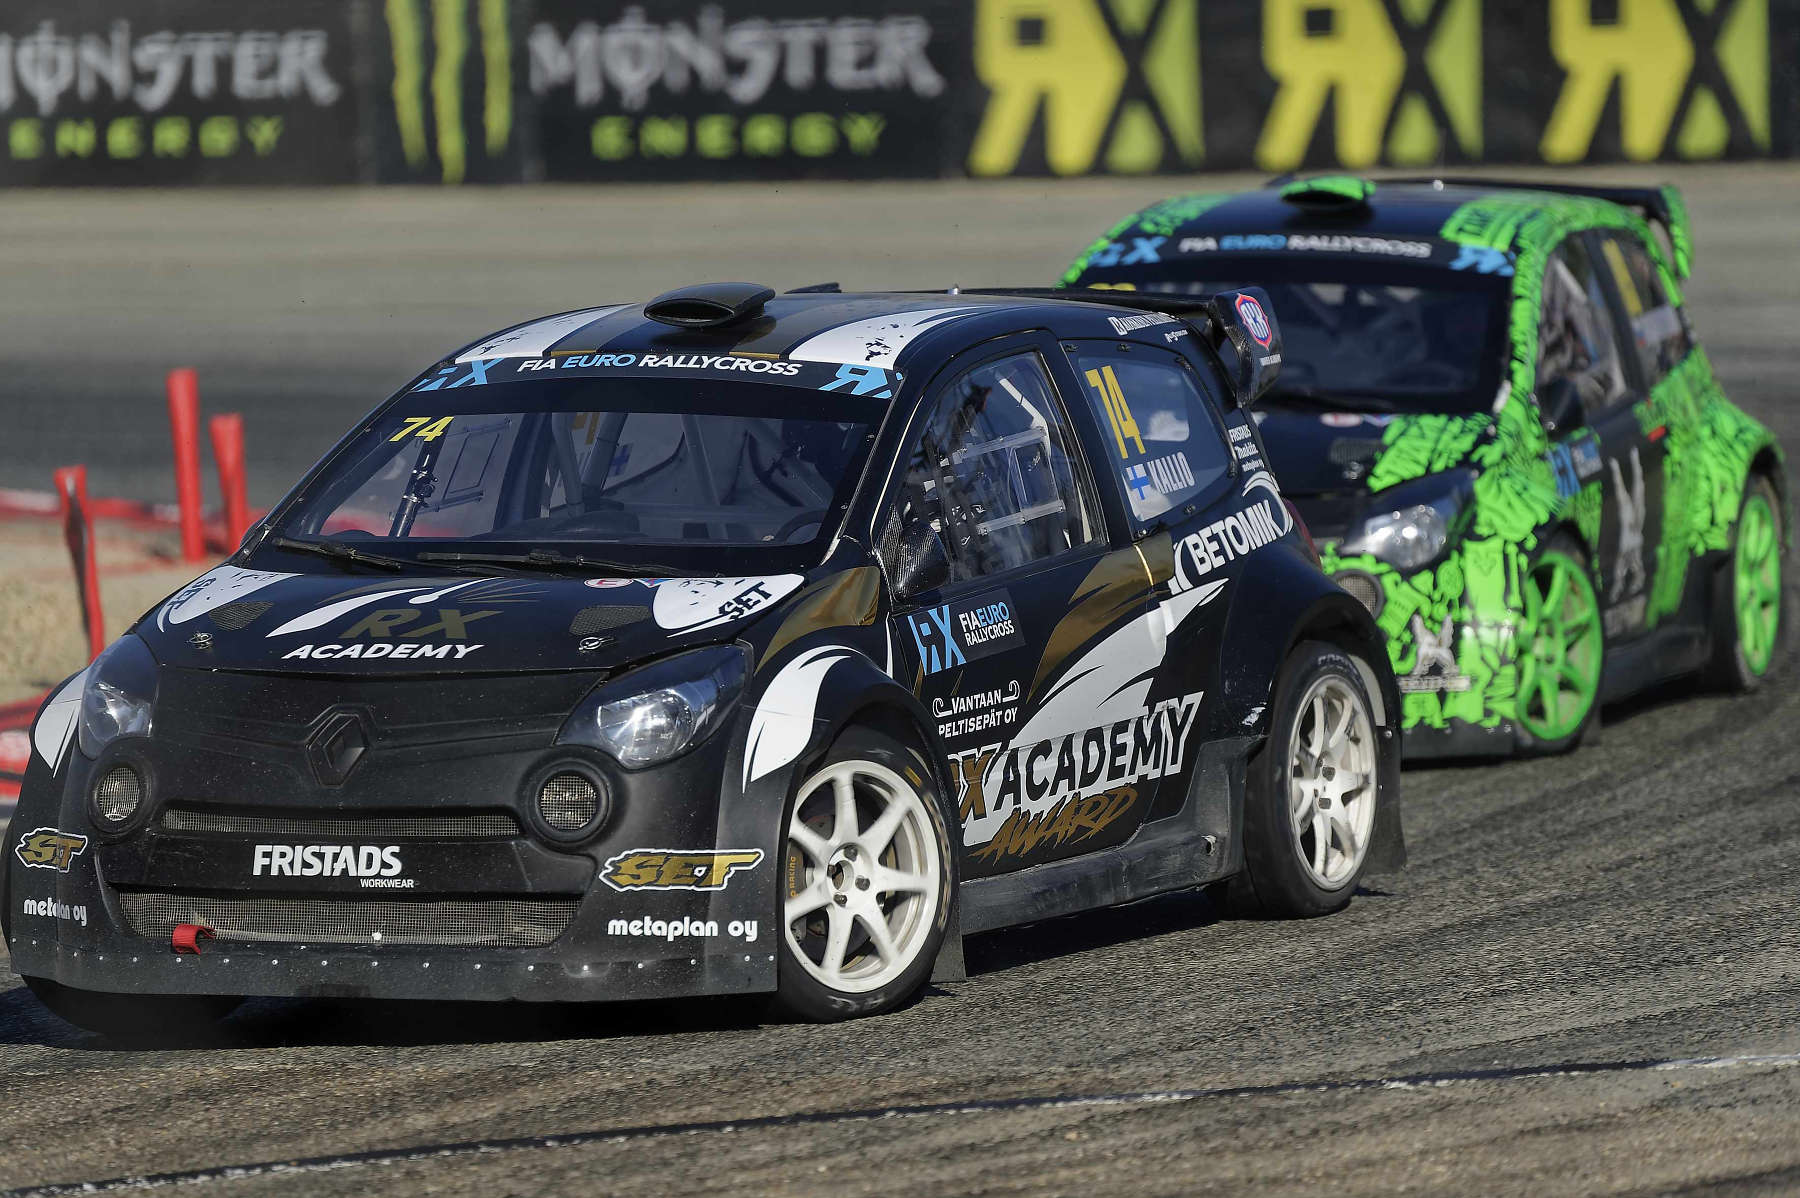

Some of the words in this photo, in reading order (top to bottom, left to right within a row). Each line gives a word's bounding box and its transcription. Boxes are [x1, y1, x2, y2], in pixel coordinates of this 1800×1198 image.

[0, 20, 340, 115] ONSTER
[527, 6, 945, 111] MONSTER
[8, 115, 284, 160] ENERGY
[591, 113, 887, 160] ENERGY
[1179, 236, 1218, 253] FIA
[1219, 234, 1287, 250] EURO
[1287, 235, 1433, 258] RALLYCROSS
[517, 359, 557, 372] FIA
[561, 354, 636, 369] EURO
[638, 354, 803, 376] RALLYCROSS
[388, 416, 454, 441] 74
[1147, 452, 1195, 494] KALLIO
[1184, 499, 1284, 576] BETOMIK
[719, 581, 771, 620] SET
[337, 609, 504, 639] RX
[964, 619, 1015, 647] RALLYCROSS
[281, 644, 485, 660] ACADEMY
[951, 688, 1001, 715] VANTAAN
[938, 708, 1003, 738] PELTISEPÄT
[1004, 706, 1018, 724] OY
[994, 692, 1203, 812] ACADEMY
[968, 784, 1138, 866] AWARD
[252, 845, 402, 877] FRISTADS
[608, 851, 761, 888] SET
[360, 879, 415, 889] WORKWEAR
[73, 905, 88, 927] oy
[607, 916, 718, 942] metaplan
[727, 920, 758, 942] oy
